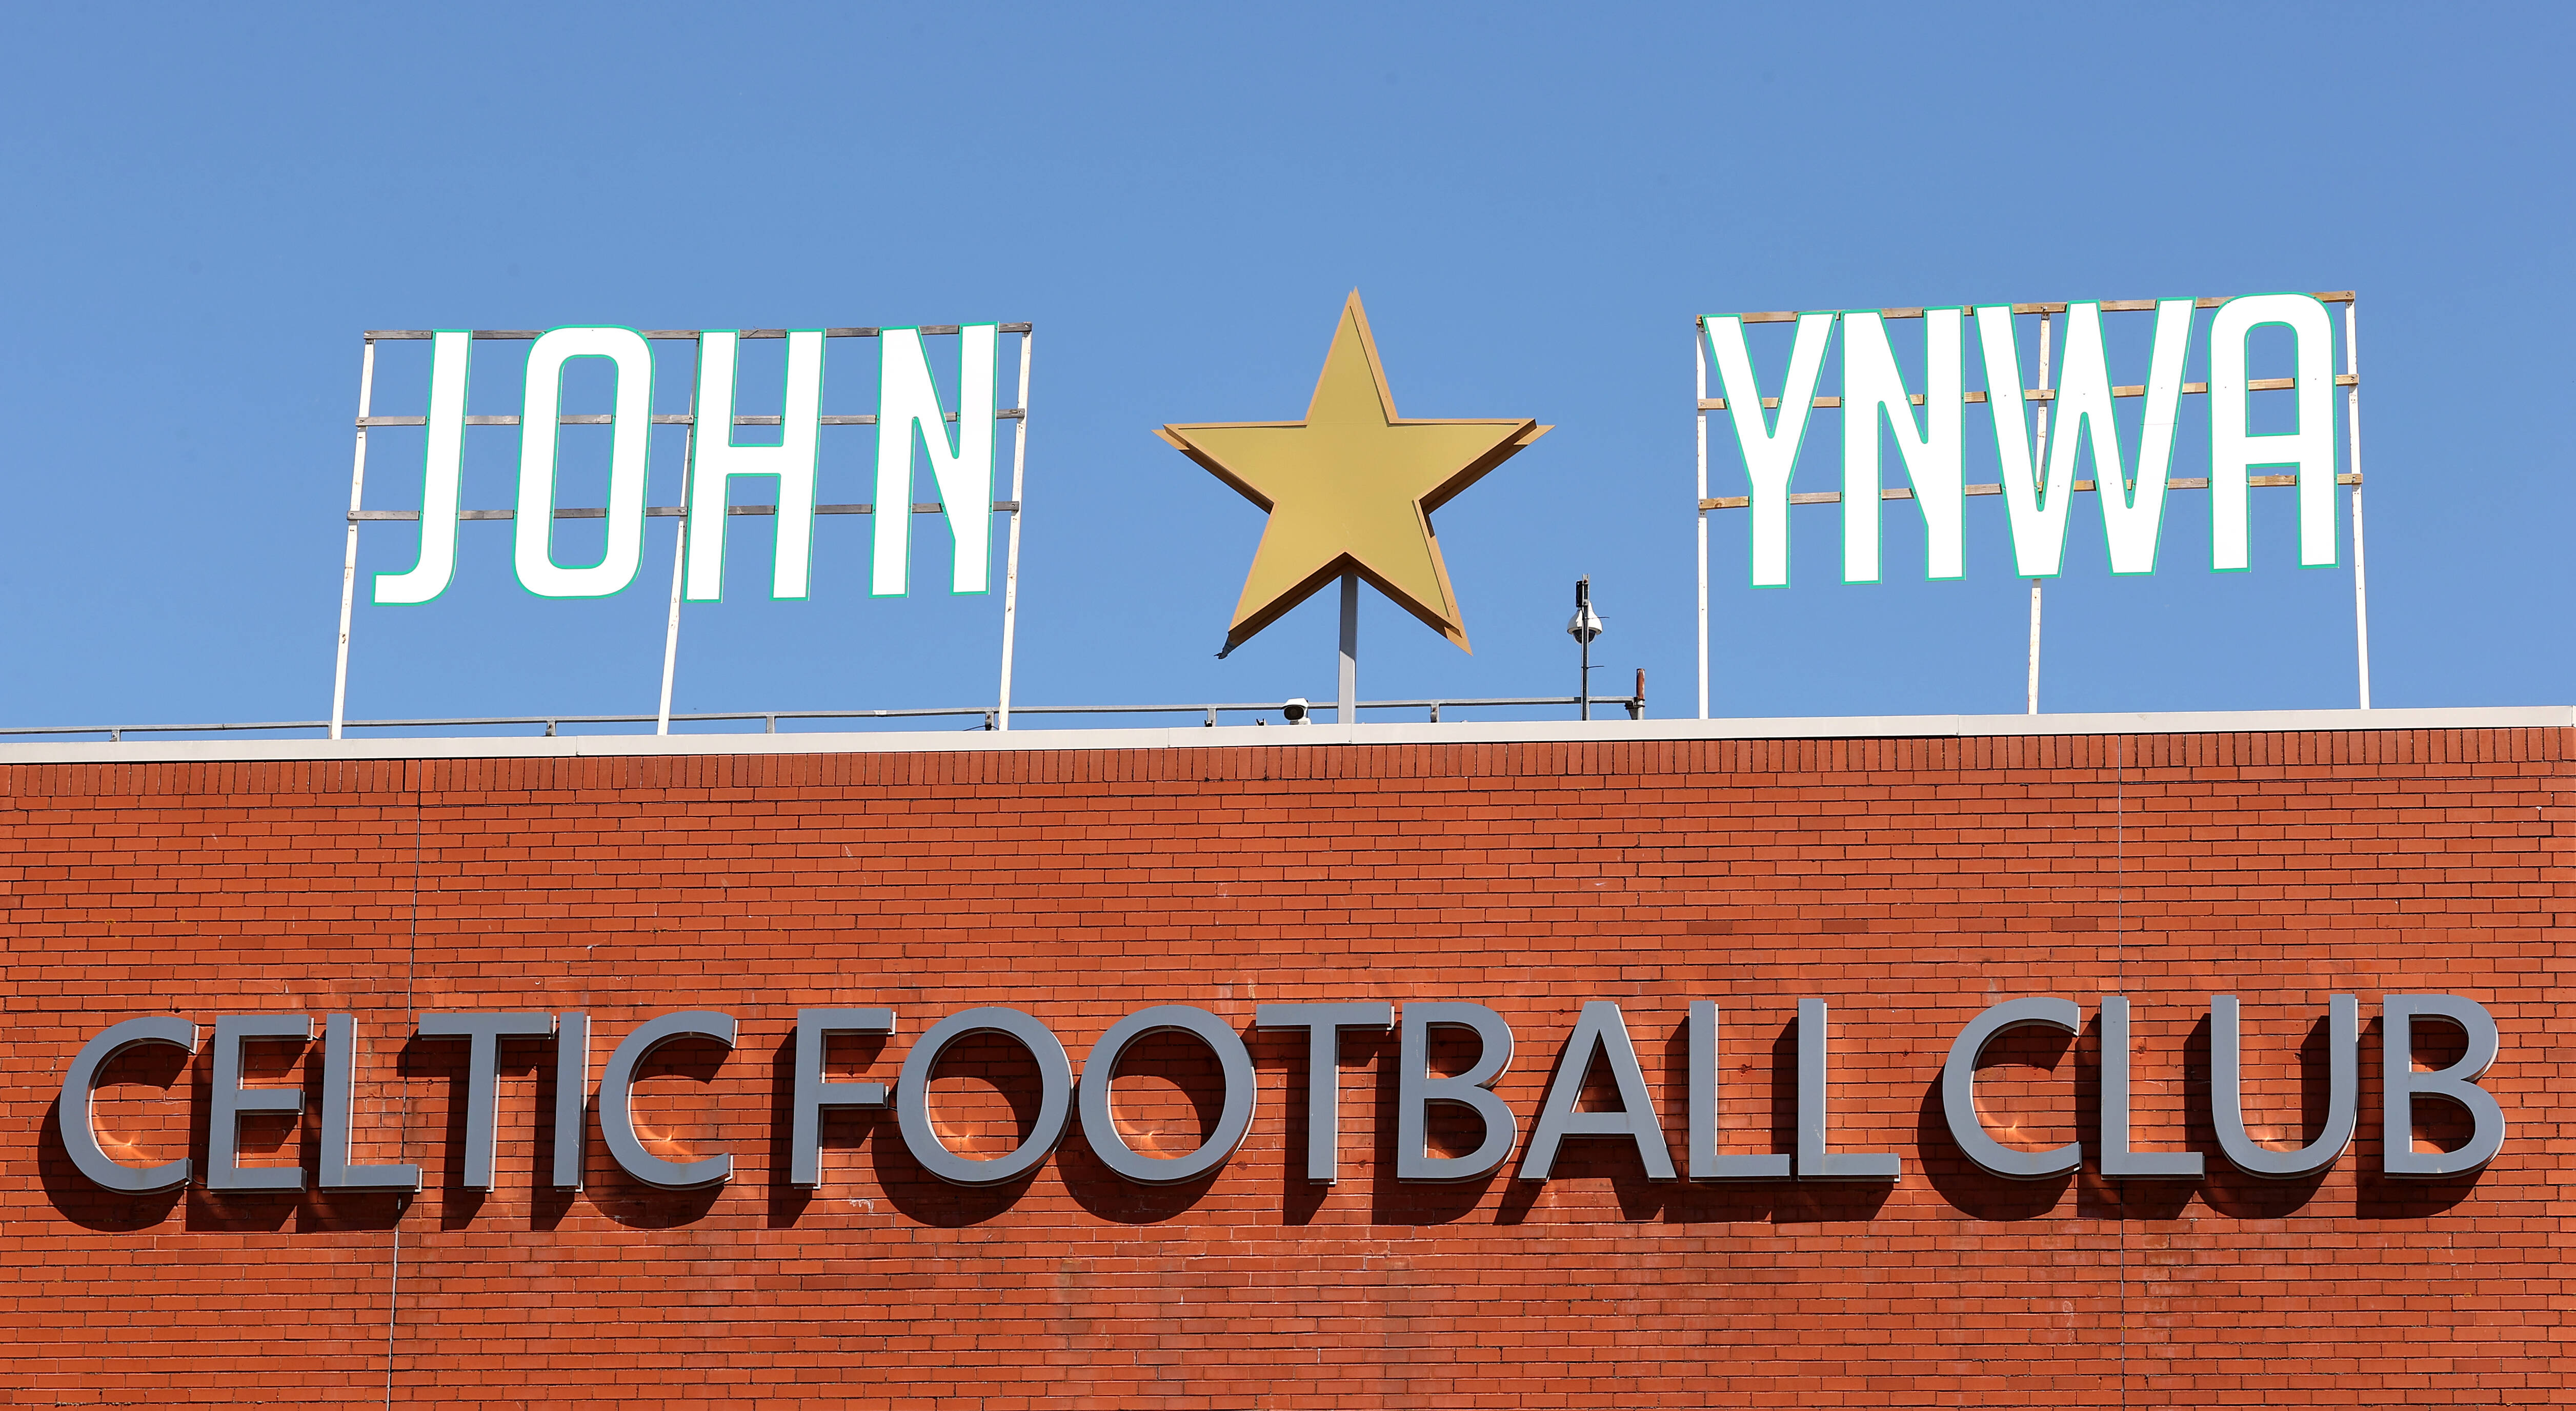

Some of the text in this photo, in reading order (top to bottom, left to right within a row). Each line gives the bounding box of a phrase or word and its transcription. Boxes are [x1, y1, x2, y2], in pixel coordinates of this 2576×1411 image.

[374, 323, 997, 606] JOHN
[1704, 292, 2338, 587] YNWA
[58, 993, 2505, 1191] CELTIC FOOTBALL CLUB
